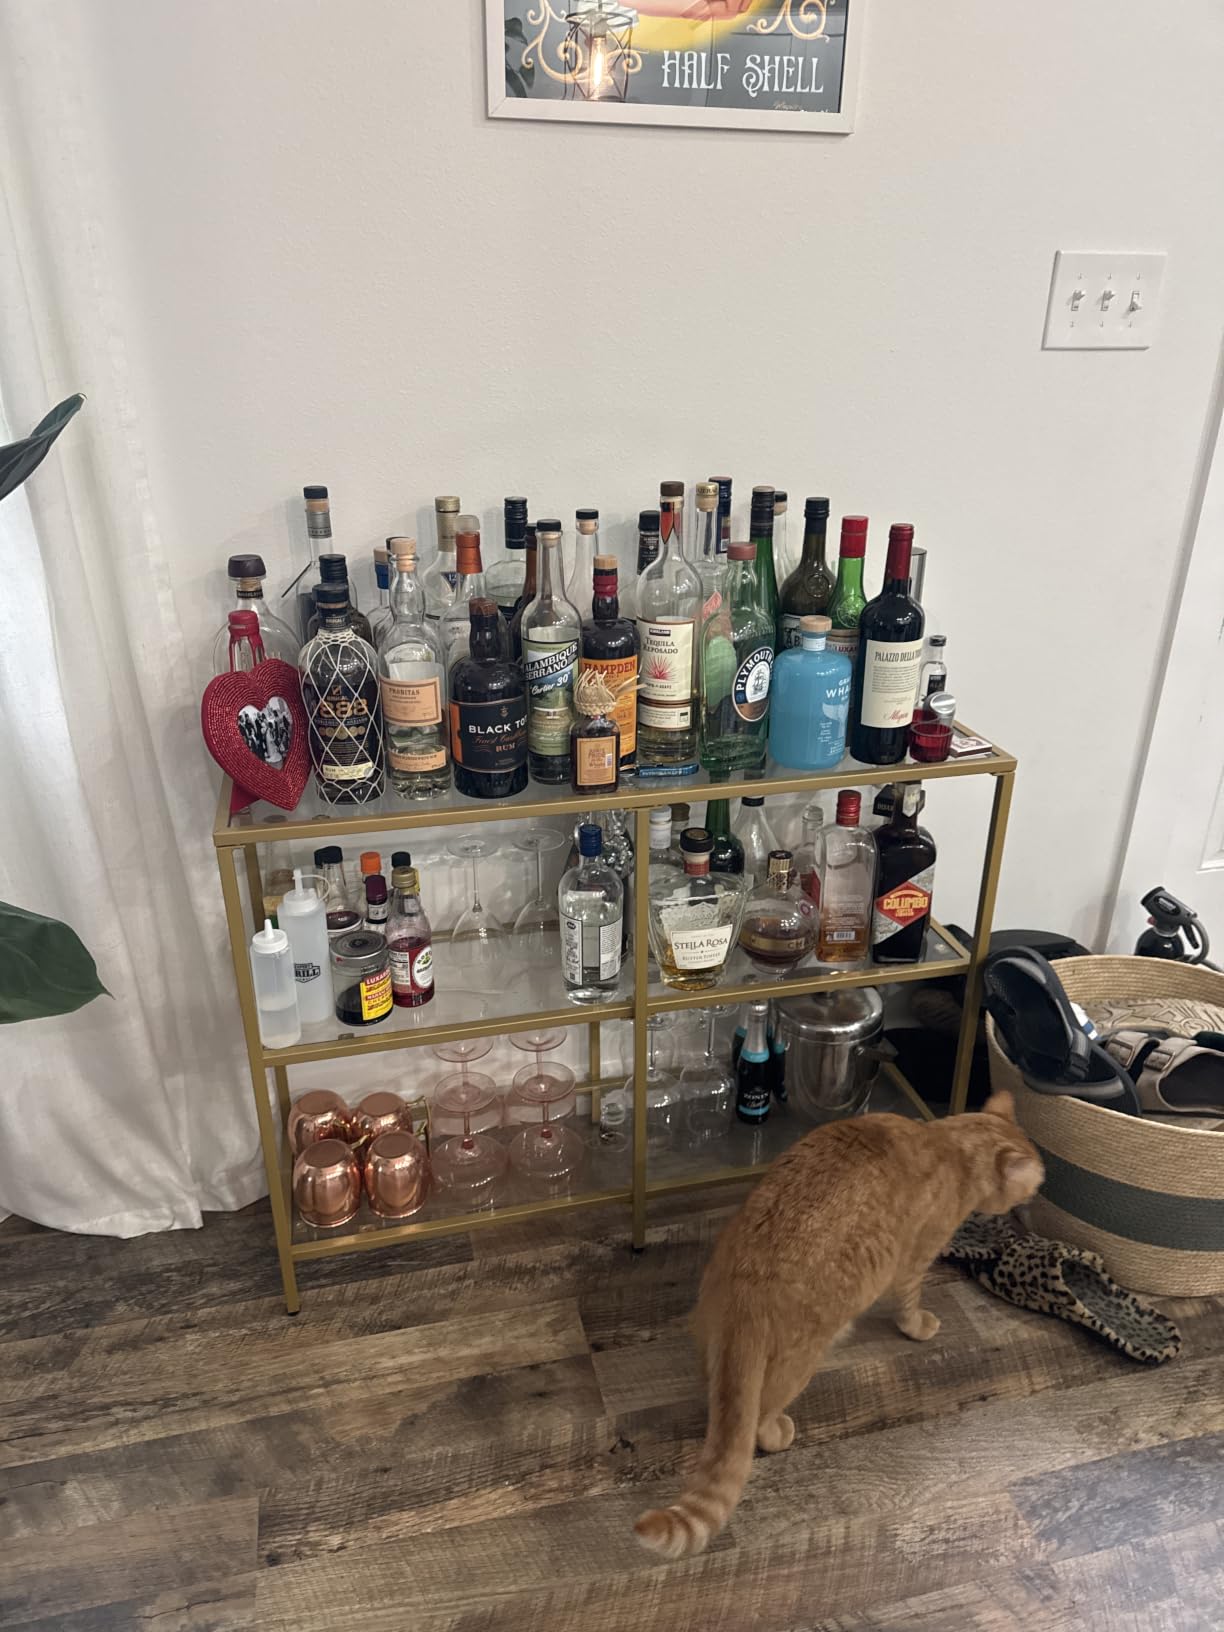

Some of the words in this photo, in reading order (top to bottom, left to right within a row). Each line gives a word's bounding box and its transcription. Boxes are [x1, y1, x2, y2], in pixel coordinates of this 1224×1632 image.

[662, 50, 731, 90] HALF
[742, 54, 824, 98] SHELL
[645, 637, 675, 647] TEQUILA
[643, 644, 679, 655] REPOSADO
[524, 641, 578, 673] ALAMBIQUE
[874, 651, 900, 662] PALAZZO
[900, 651, 915, 662] DELLA
[583, 661, 635, 674] HAMPDEN
[736, 650, 773, 691] PLYMOUTH
[826, 685, 850, 699] WHA
[320, 698, 369, 719] 888
[468, 723, 512, 734] BLACK
[495, 742, 516, 753] RUM
[674, 941, 704, 950] STELLA
[707, 938, 728, 947] ROSA
[295, 969, 319, 977] RILL
